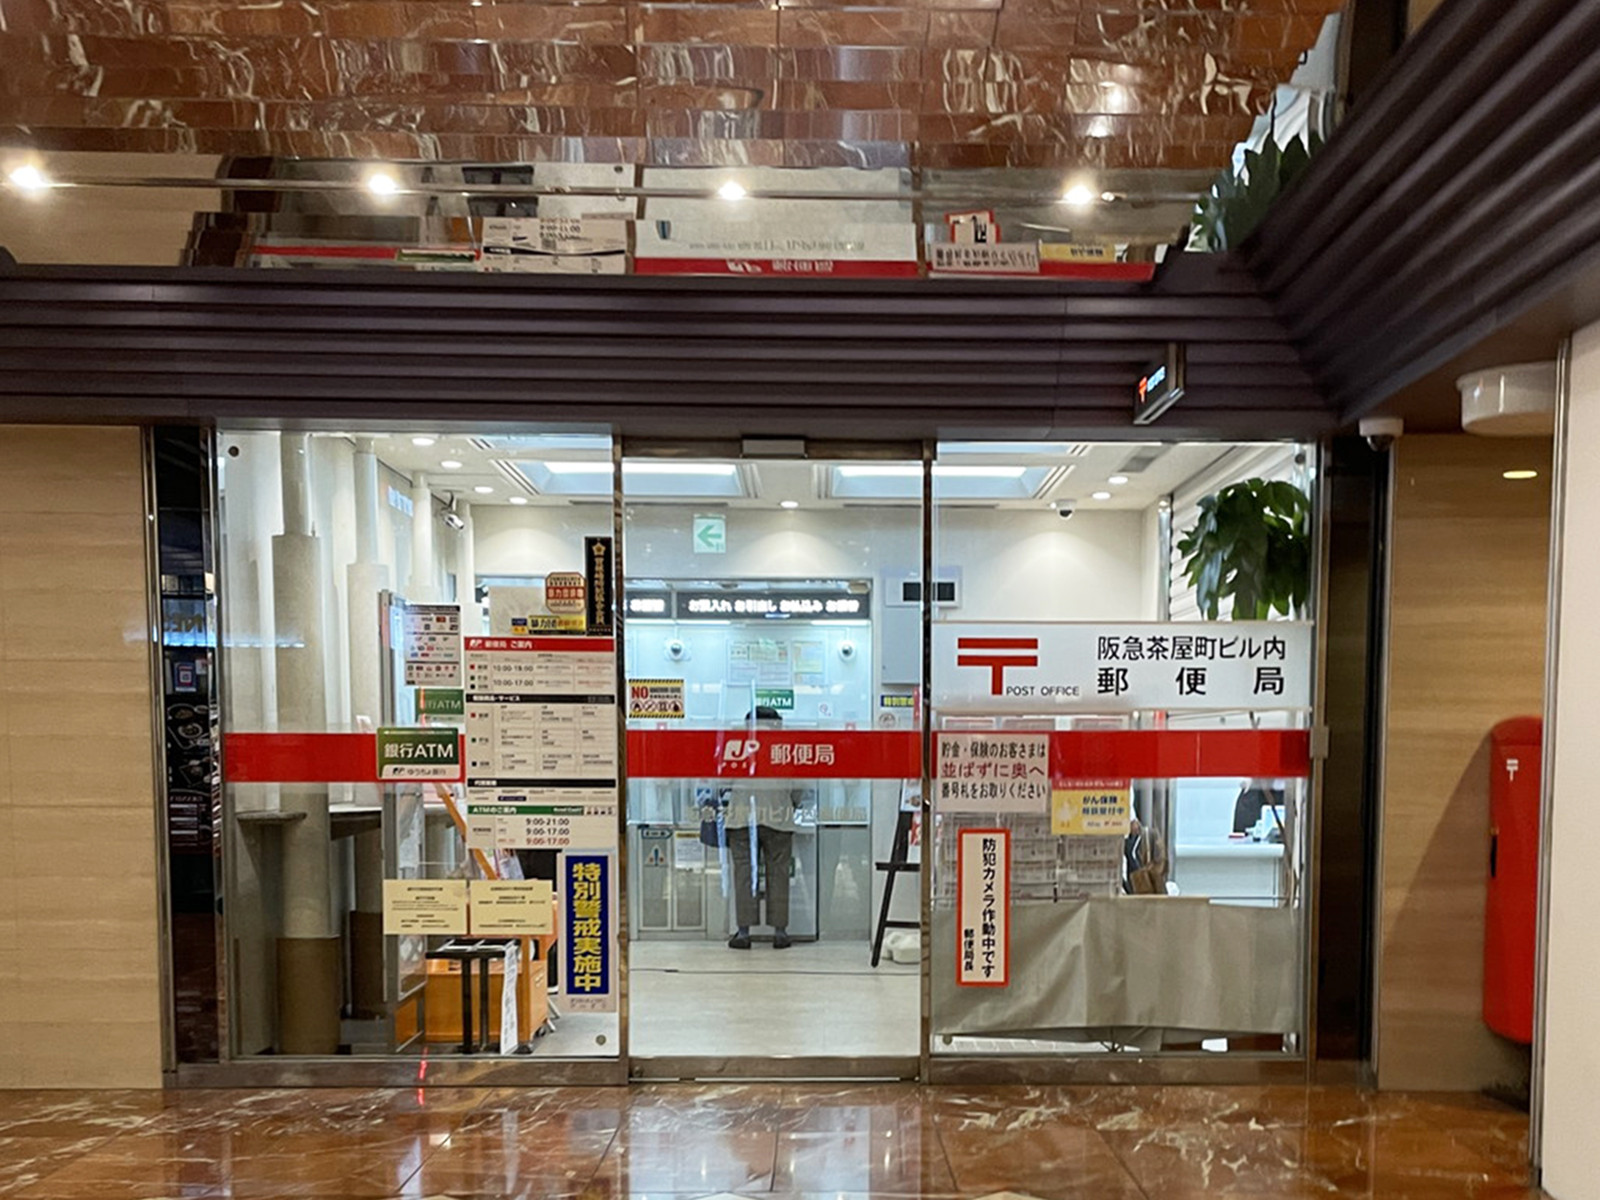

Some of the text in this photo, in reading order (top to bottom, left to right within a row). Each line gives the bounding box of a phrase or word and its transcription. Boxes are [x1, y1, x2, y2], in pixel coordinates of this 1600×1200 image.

[1097, 635, 1286, 660] 阪急茶屋町ビル内
[631, 686, 649, 699] NO
[1006, 686, 1080, 696] POST OFFICE
[384, 743, 454, 759] 銀行ATM
[770, 743, 834, 766] 郵便局
[941, 741, 1046, 759] 貯金・保険のお客さまは
[941, 762, 1045, 779] 並ばずに奥へ
[941, 782, 1046, 799] 番号札をお取りください
[981, 838, 997, 979] 防犯カメラ作動中です
[572, 862, 602, 992] 特別警戒実施中
[964, 928, 975, 972] 郵便局長
